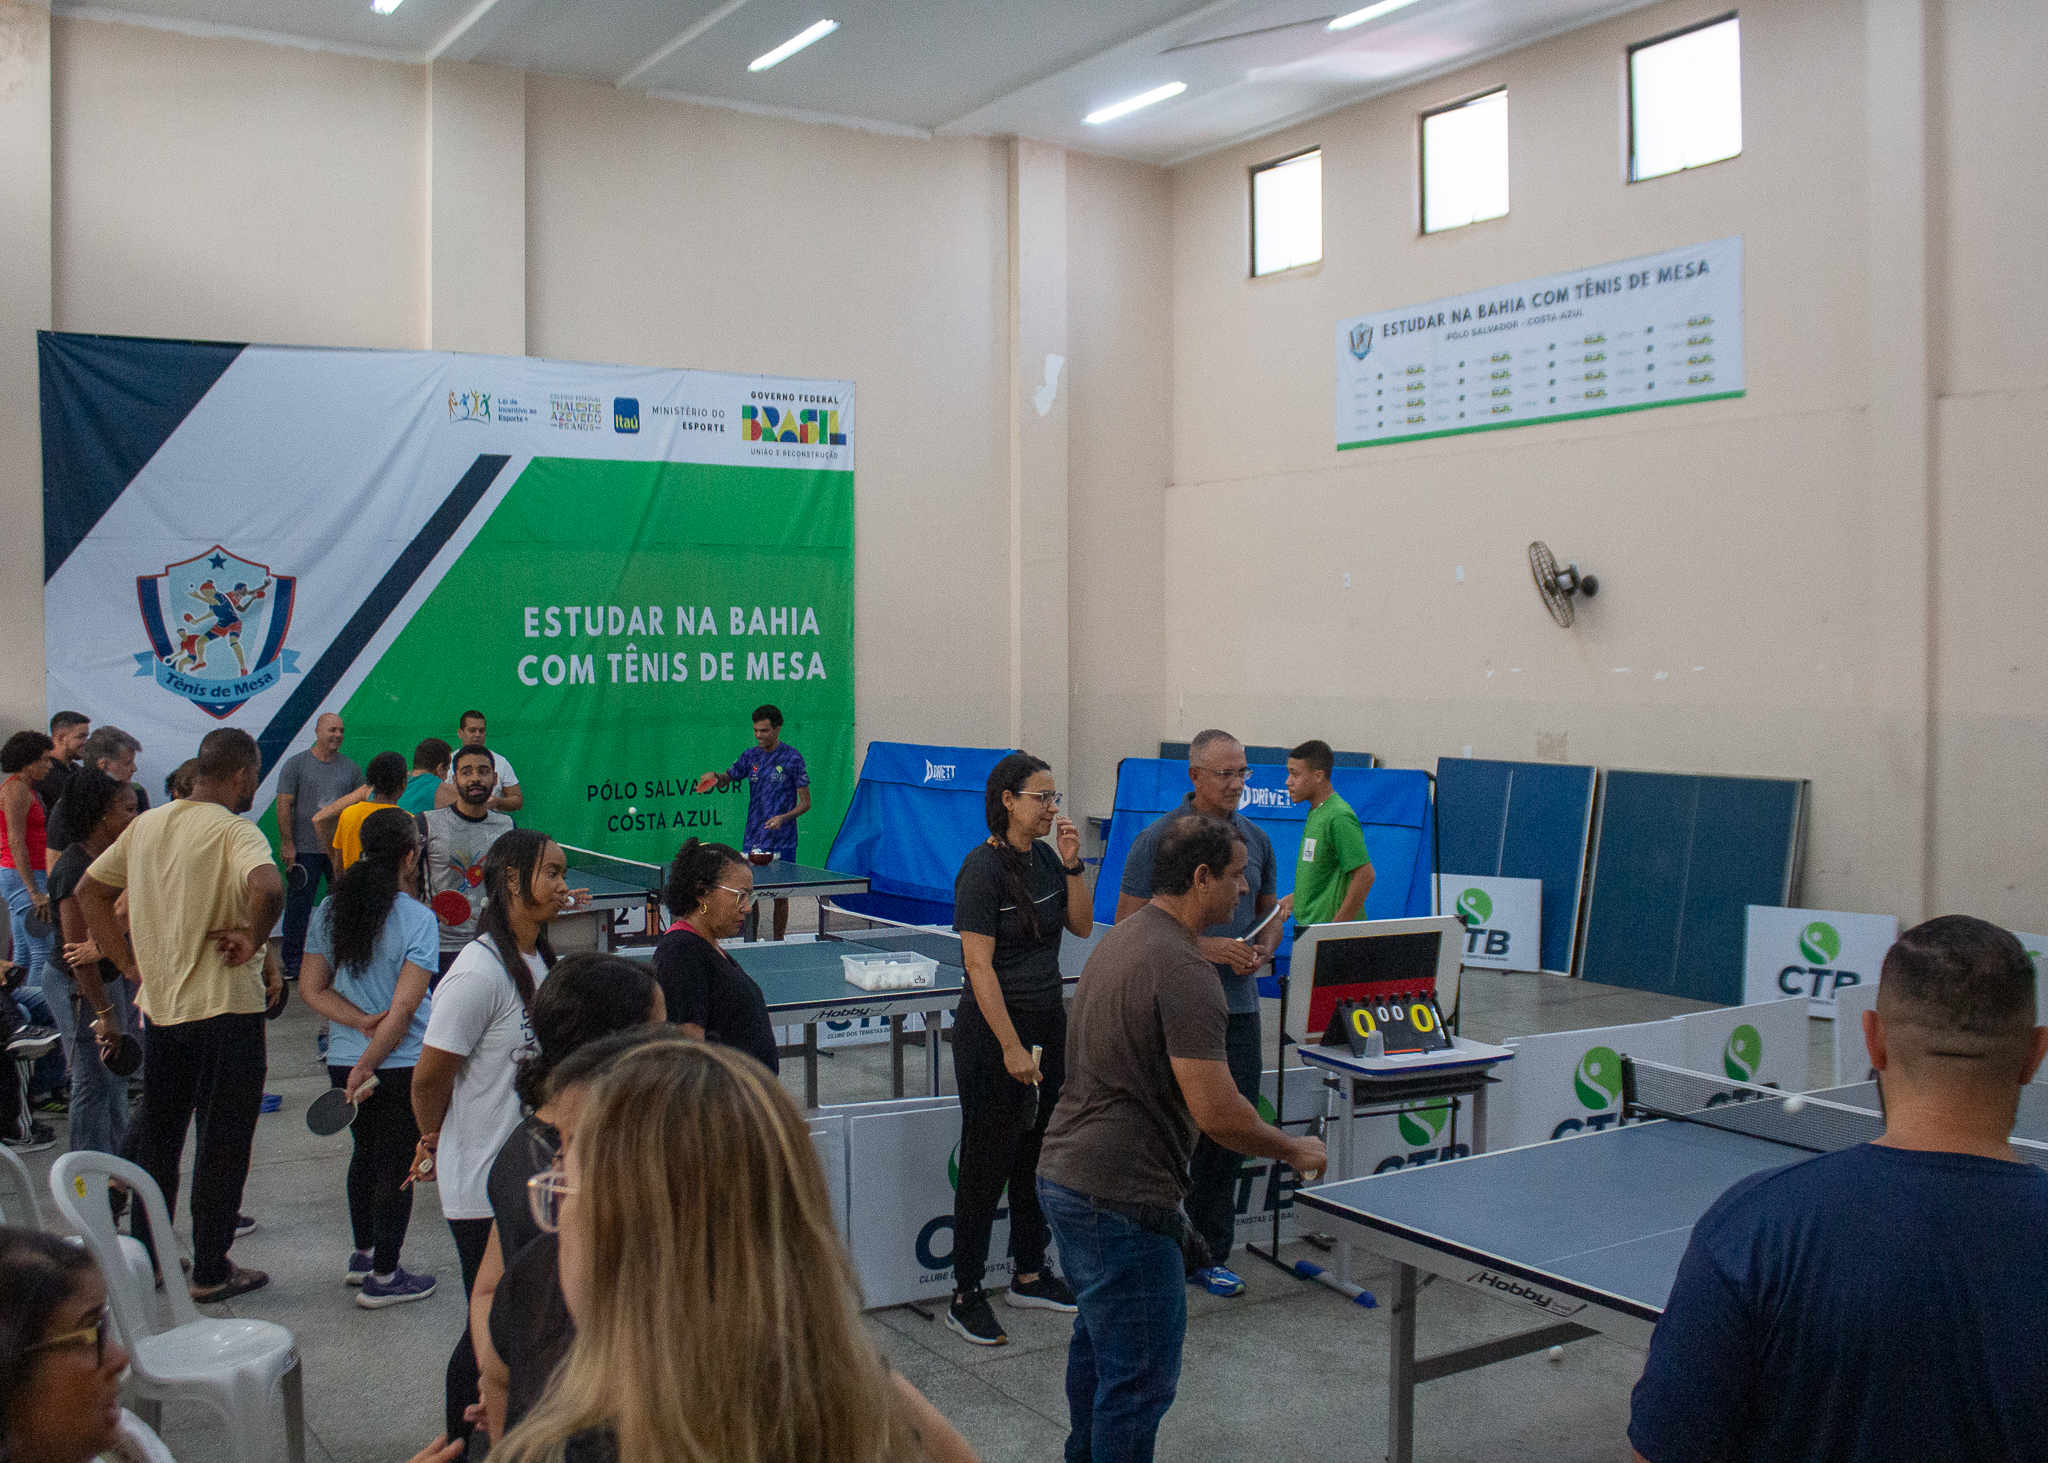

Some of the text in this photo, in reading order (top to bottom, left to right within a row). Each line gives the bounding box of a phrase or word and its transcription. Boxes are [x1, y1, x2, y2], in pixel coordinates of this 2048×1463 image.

[1383, 259, 1711, 338] ESTUDAR NA BAHIA COM TÊNIS DE MESA
[1471, 320, 1519, 337] SALVADOR
[1527, 315, 1558, 326] COSTA
[750, 391, 839, 405] GOVERNO FEDERAL
[615, 414, 639, 429] Itaú
[652, 405, 725, 418] MINISTÉRIO DO
[683, 421, 725, 432] ESPORTE
[742, 404, 847, 445] BRASIL
[751, 447, 774, 456] UNIÃO
[783, 450, 839, 459] RECONSTRUÇÃO
[524, 606, 820, 637] ESTUDAR NA BAHIA
[517, 642, 827, 686] COM TÊNIS DE MESA
[166, 672, 274, 697] Tênis de Mesa
[587, 778, 638, 802] PÓLO
[608, 809, 723, 832] COSTA AZUL
[1466, 928, 1511, 955] TB
[818, 1007, 870, 1019] Hobby
[1410, 1004, 1434, 1032] 0
[1235, 1214, 1267, 1226] ENISTAS
[919, 1271, 949, 1284] CLUBE
[1478, 1271, 1553, 1307] Hobby
